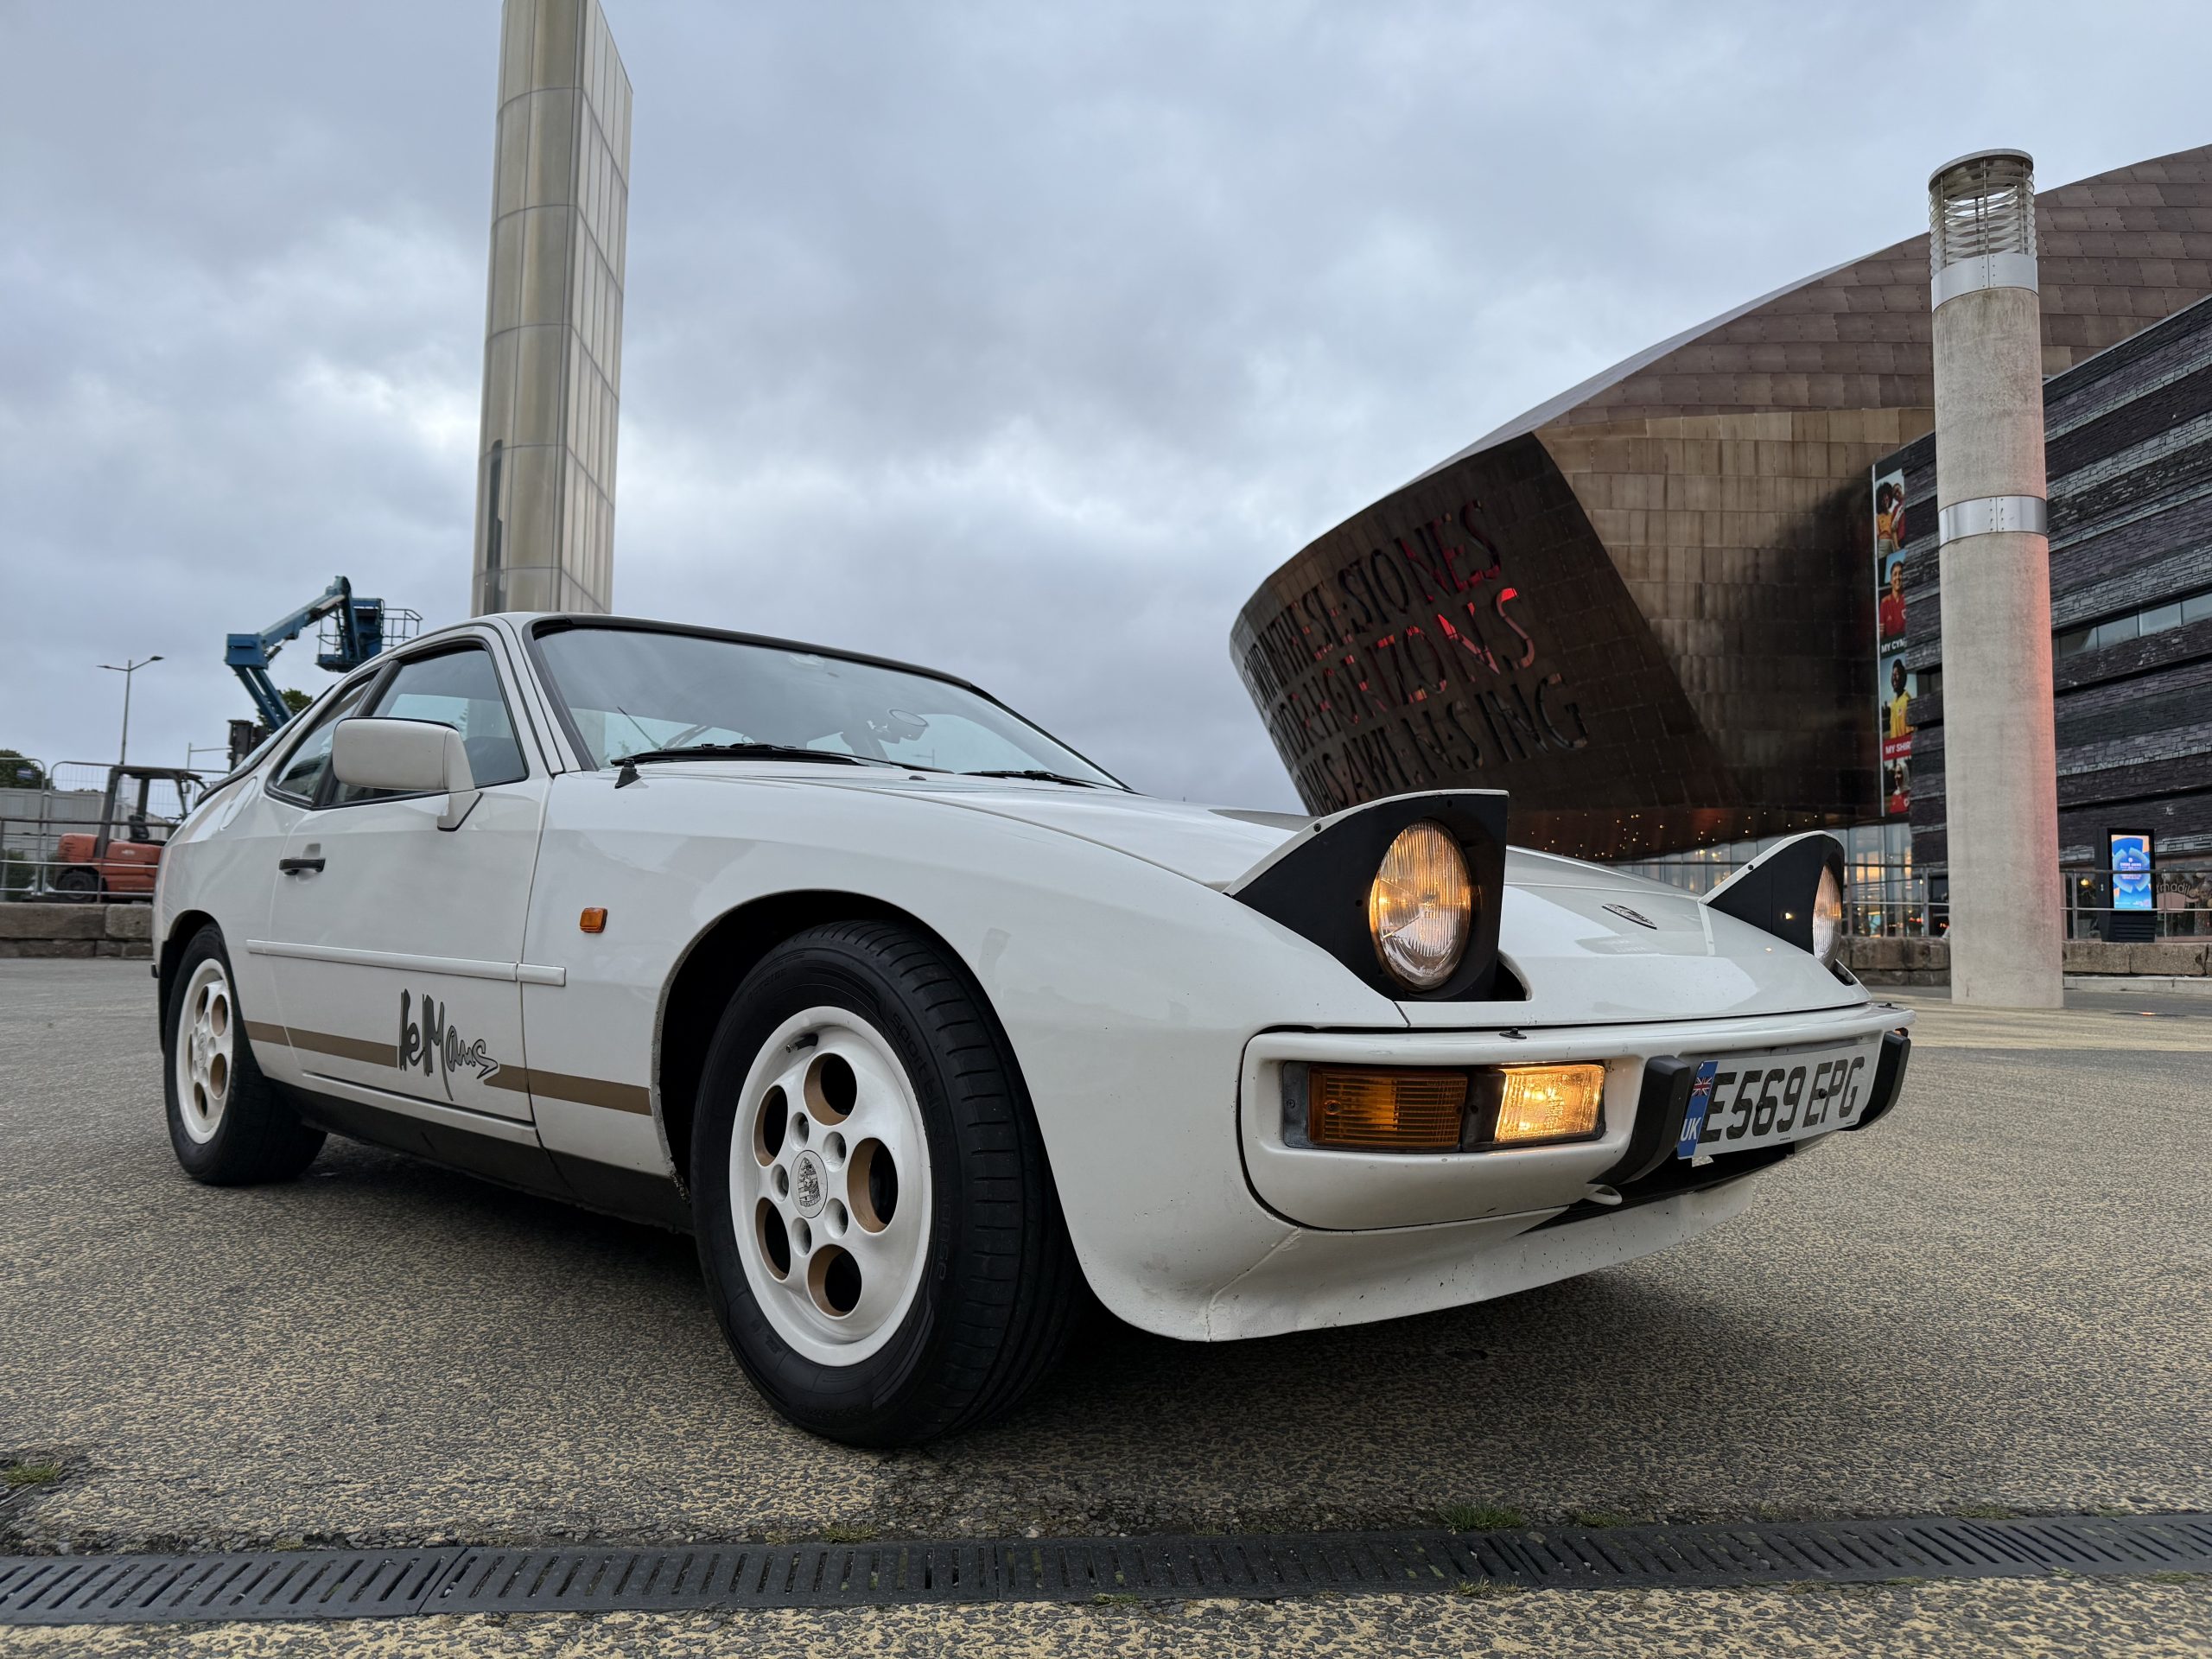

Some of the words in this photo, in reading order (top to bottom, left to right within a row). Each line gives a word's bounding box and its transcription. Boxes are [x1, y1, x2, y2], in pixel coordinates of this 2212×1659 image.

[1338, 499, 1501, 635] STONES
[1302, 588, 1535, 738] HORIZONS
[1881, 642, 1891, 654] MY
[1891, 638, 1907, 650] CYM
[1446, 673, 1589, 771] SING
[1885, 744, 1895, 754] MY
[1896, 741, 1912, 753] SHIR
[1680, 1116, 1702, 1142] UK
[1698, 1065, 1807, 1144] E569
[1802, 1056, 1866, 1128] EPG
